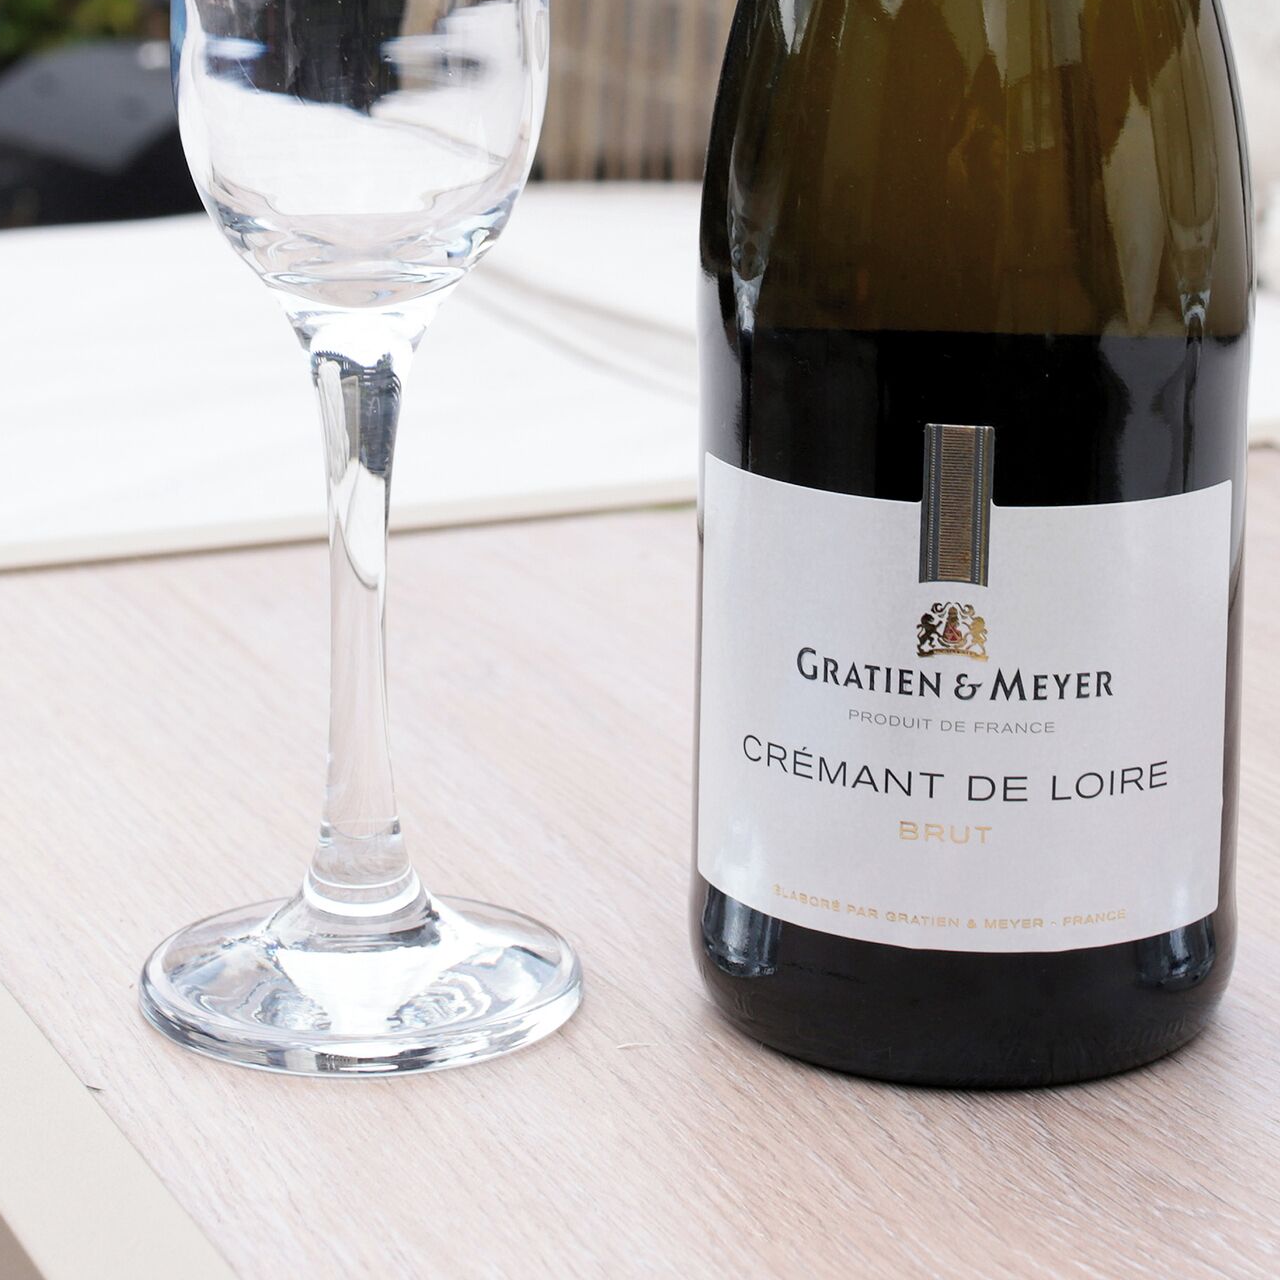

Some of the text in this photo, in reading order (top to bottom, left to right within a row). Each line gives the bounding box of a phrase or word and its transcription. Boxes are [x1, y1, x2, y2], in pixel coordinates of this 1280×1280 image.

[796, 646, 1114, 702] GRATIEN & MEYER
[848, 708, 1056, 734] PRODUIT DE FRANCE
[742, 734, 1168, 802] CRÉMANT DE LOIRE
[898, 820, 993, 845] BRUT
[846, 903, 879, 920] PAR
[884, 910, 960, 928] GRATIEN
[984, 917, 1044, 930] MEYER
[1062, 908, 1127, 927] FRANCE
